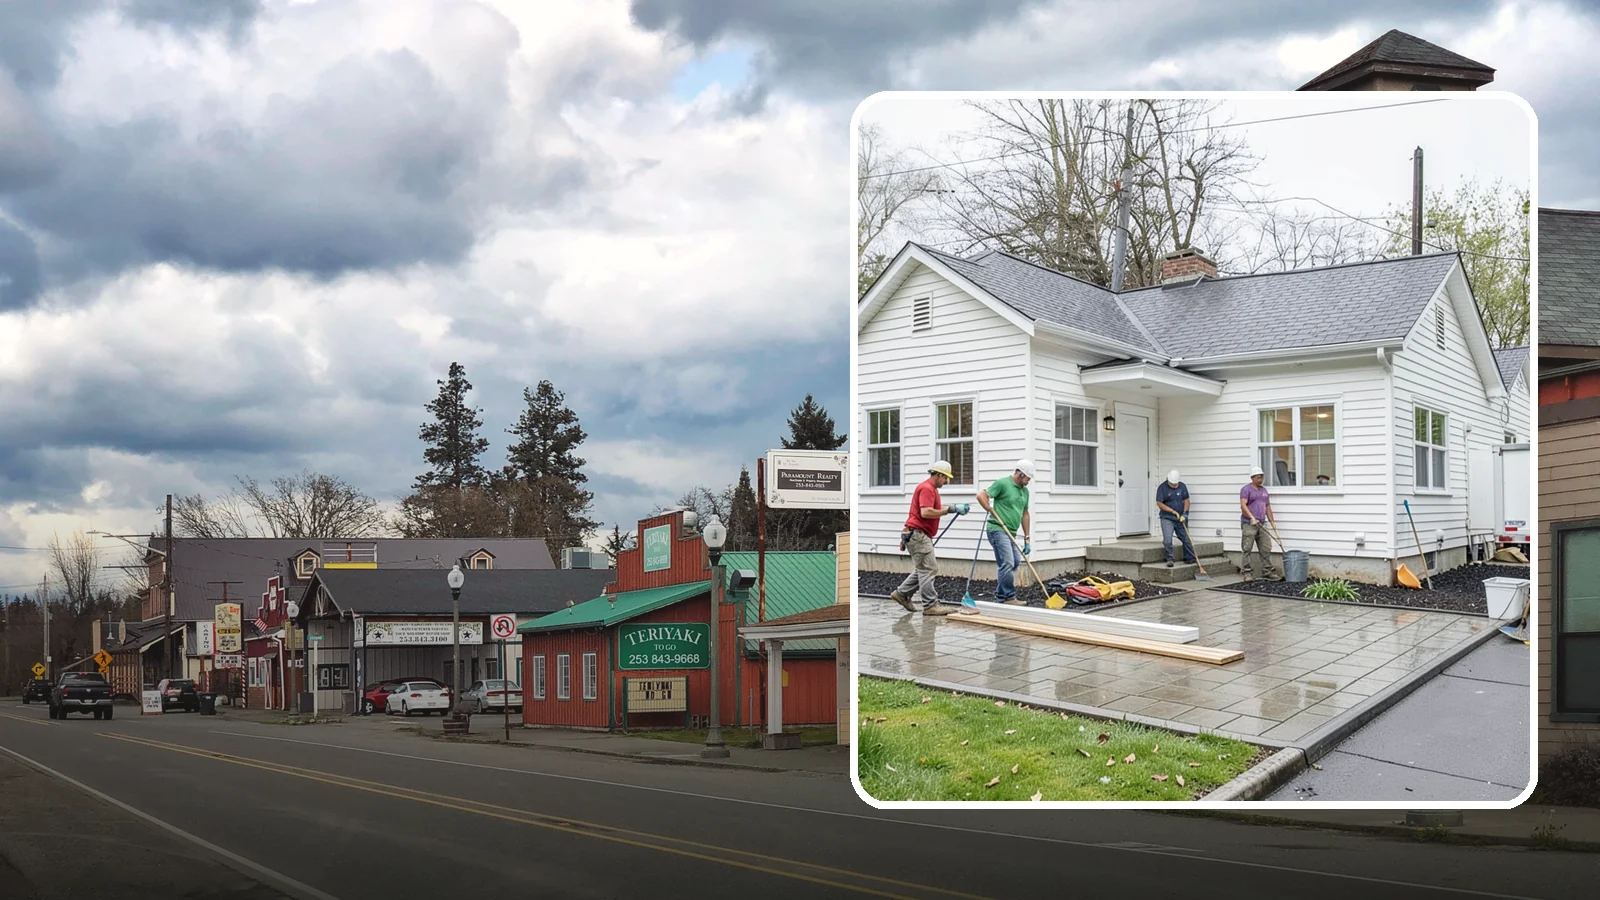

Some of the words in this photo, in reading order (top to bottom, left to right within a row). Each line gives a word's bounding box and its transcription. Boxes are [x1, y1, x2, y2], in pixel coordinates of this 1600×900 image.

[781, 471, 815, 479] PARAMOUNT
[817, 472, 839, 480] REALTY
[625, 627, 703, 646] TERIYAKI
[629, 654, 649, 665] 253
[651, 653, 700, 664] 843-9668
